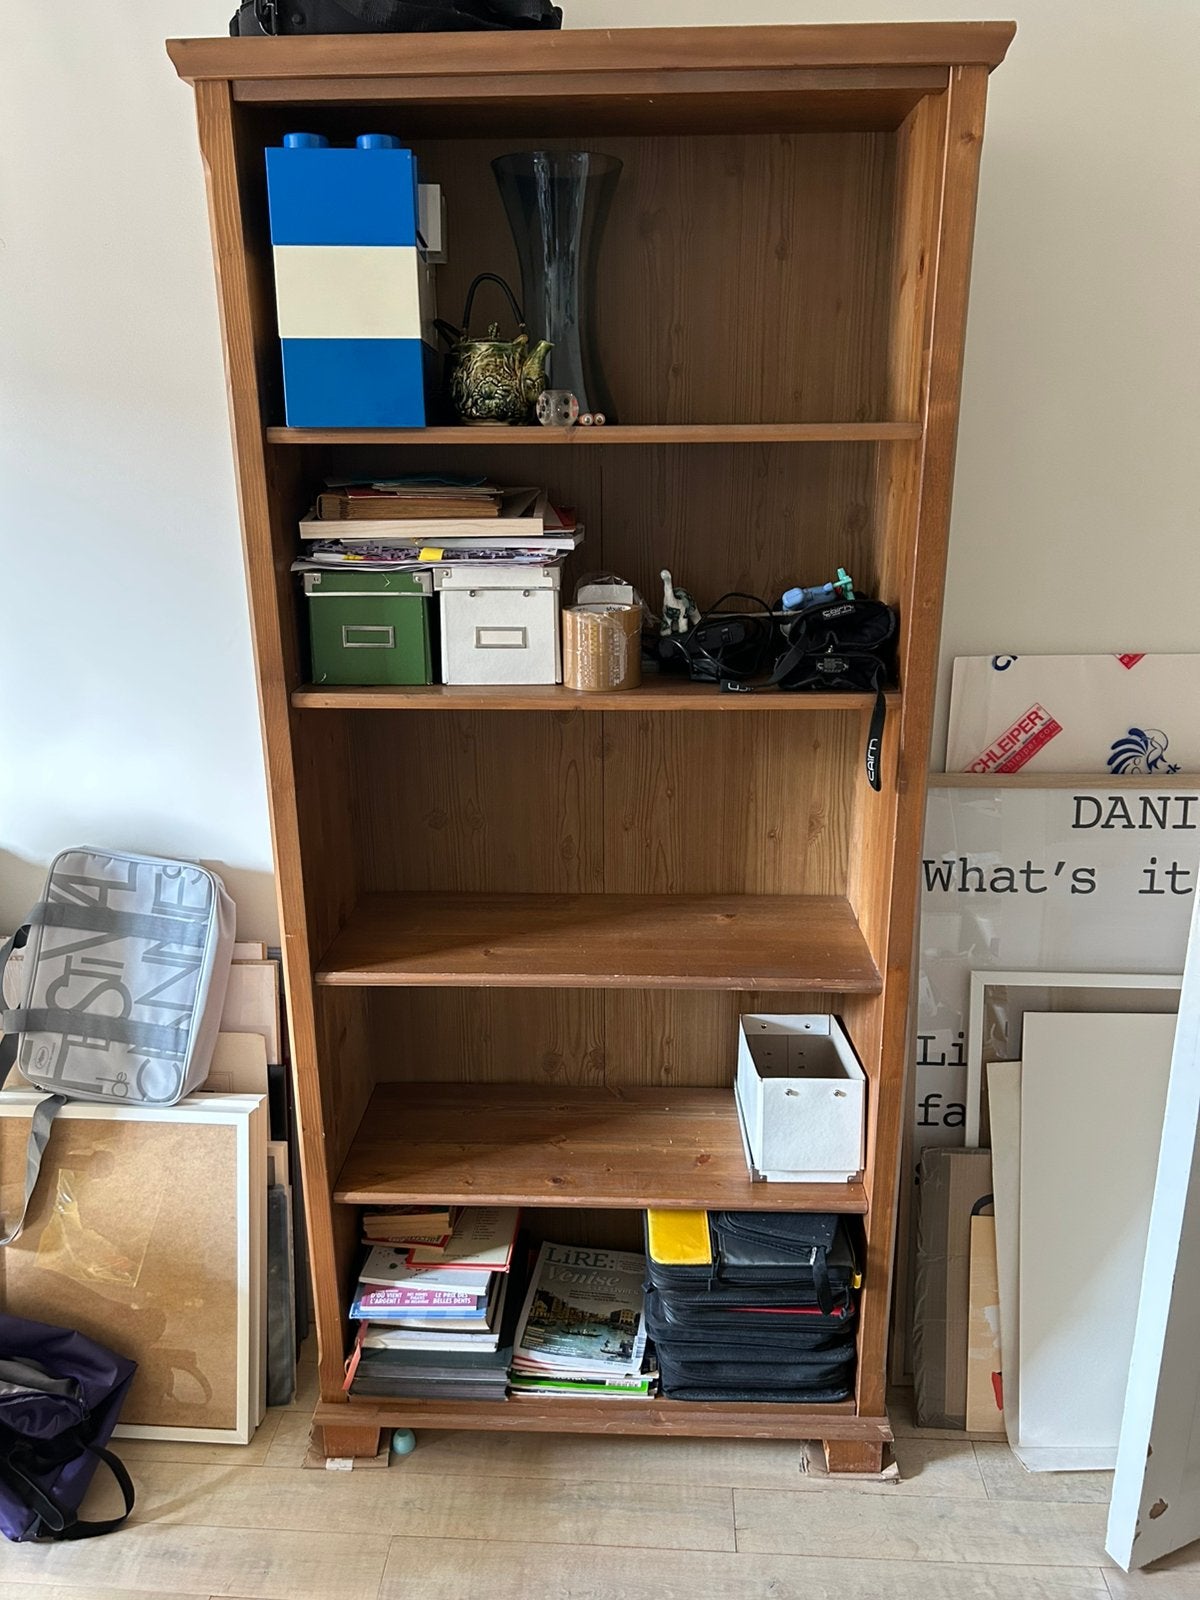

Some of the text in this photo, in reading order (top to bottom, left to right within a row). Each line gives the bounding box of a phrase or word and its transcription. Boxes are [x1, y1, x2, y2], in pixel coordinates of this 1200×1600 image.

[964, 710, 1045, 773] CHLEIPER
[1071, 796, 1199, 829] DANI
[922, 857, 1193, 895] What's it
